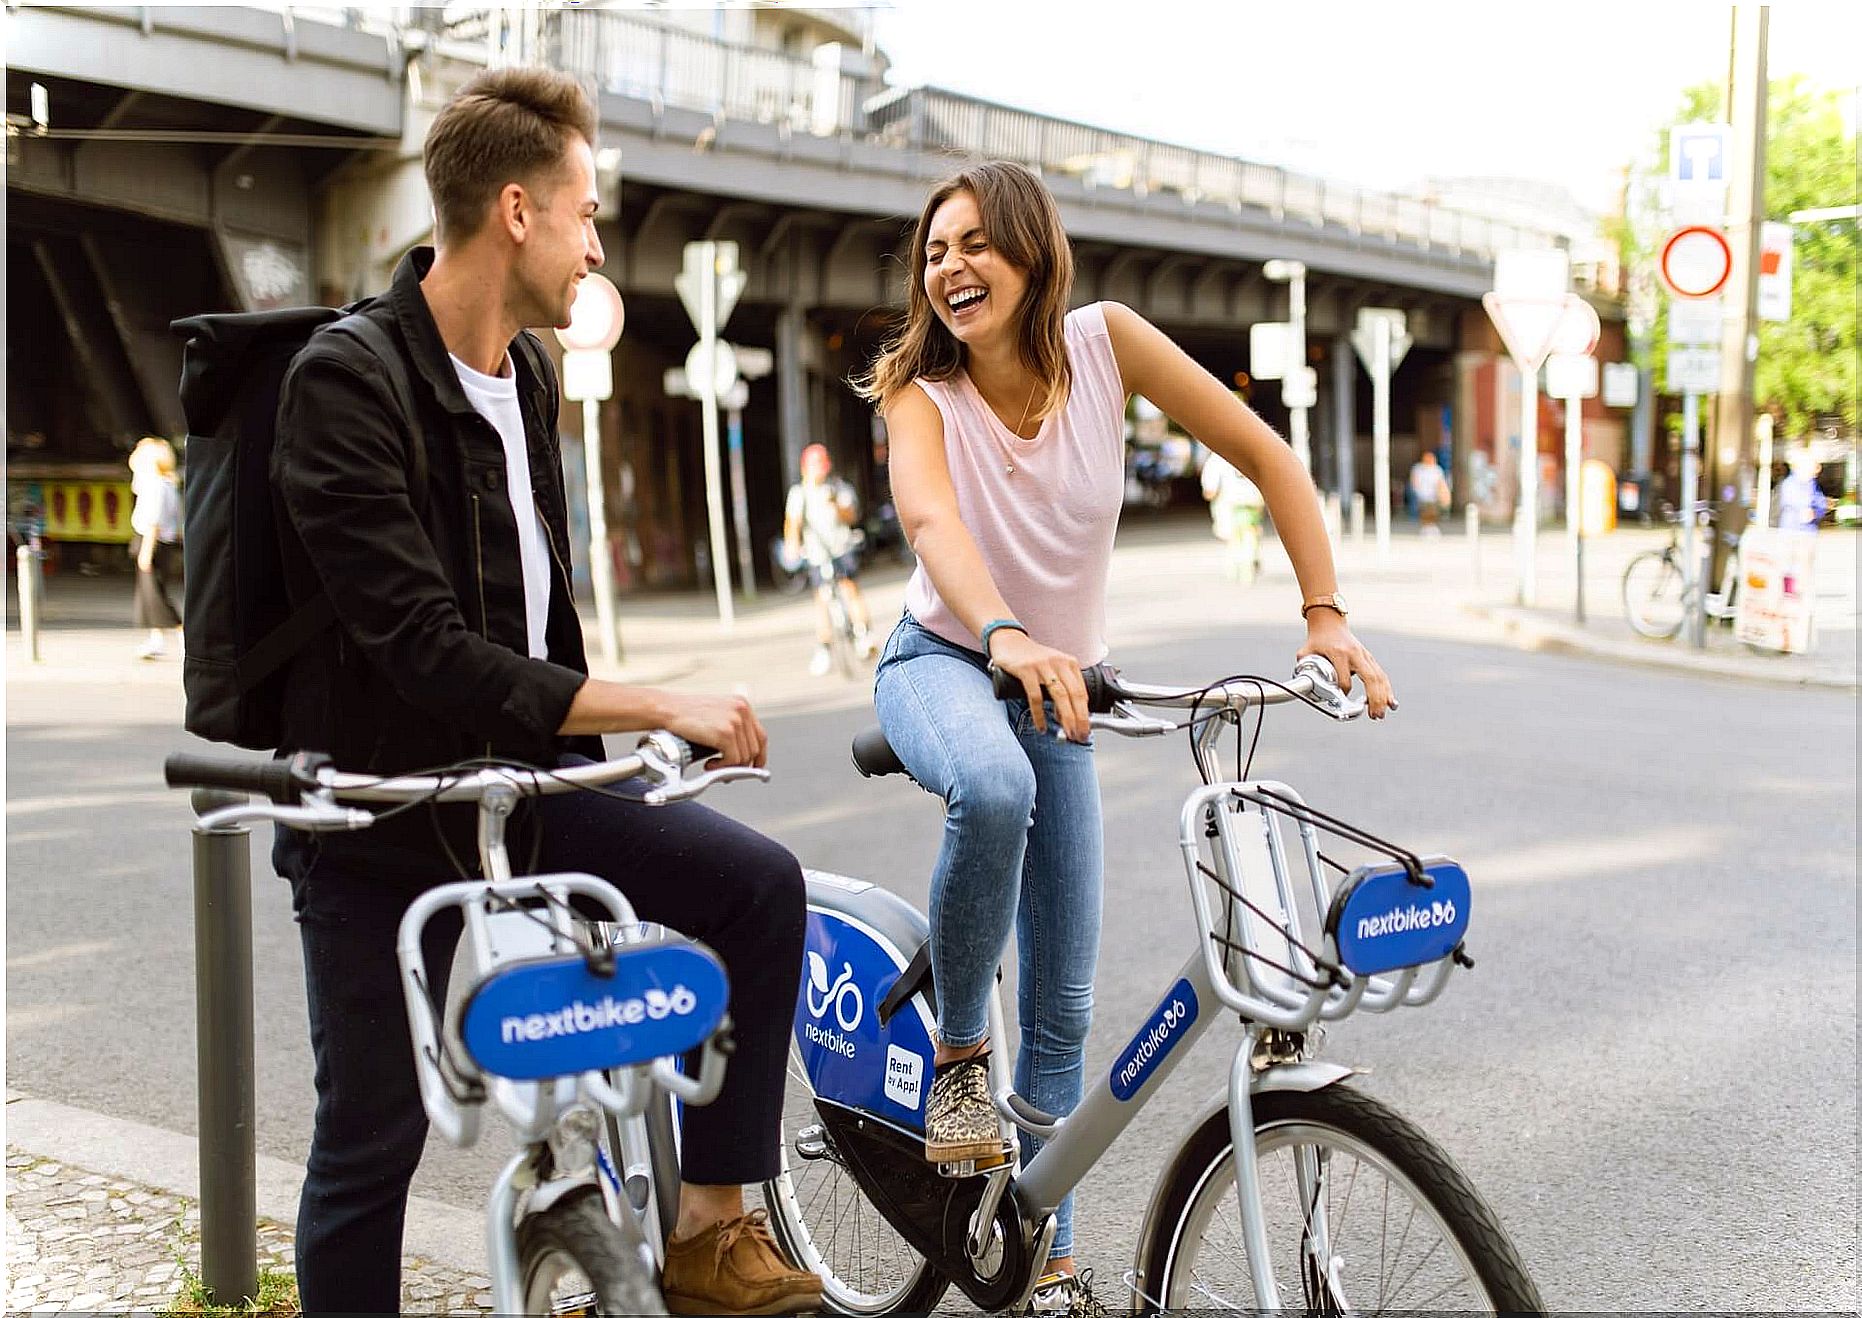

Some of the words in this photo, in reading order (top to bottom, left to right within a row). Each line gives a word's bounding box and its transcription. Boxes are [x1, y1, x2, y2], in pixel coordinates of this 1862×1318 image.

[1357, 904, 1431, 940] nextbike
[502, 996, 645, 1043] nextbike
[805, 1023, 856, 1059] nextbike
[1120, 1022, 1168, 1087] nextbike
[890, 1057, 914, 1075] Rent
[897, 1078, 918, 1094] App!
